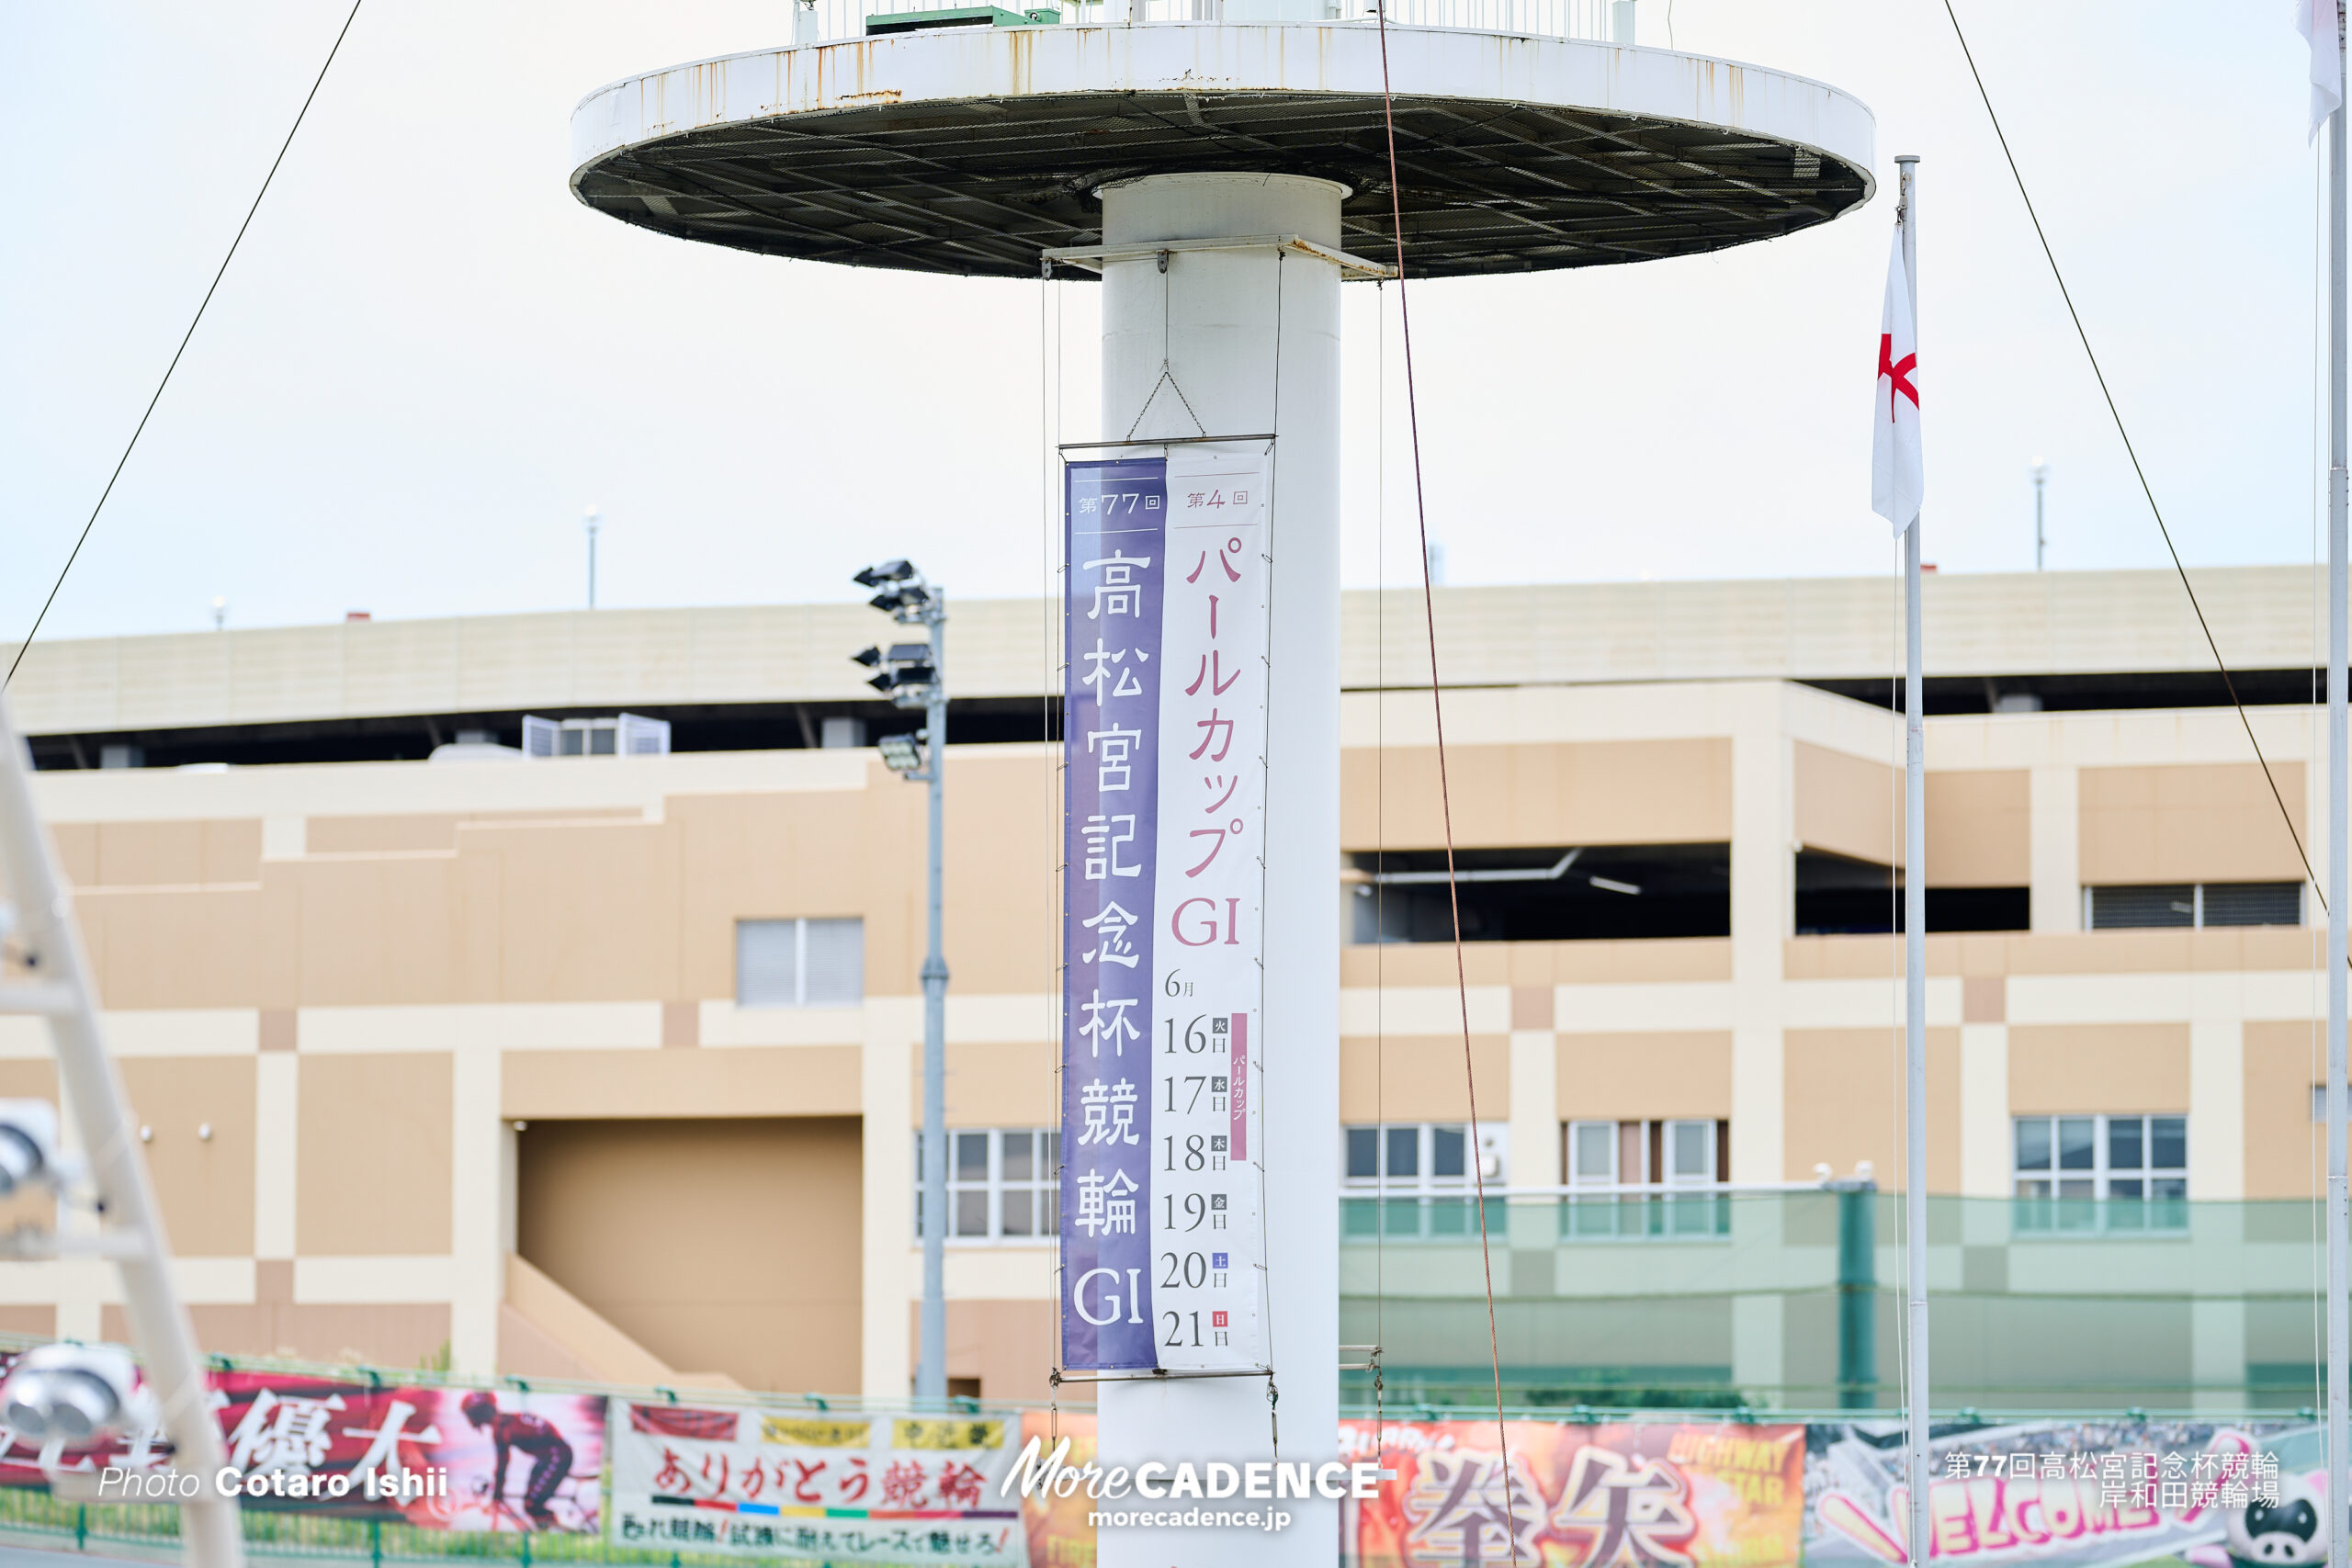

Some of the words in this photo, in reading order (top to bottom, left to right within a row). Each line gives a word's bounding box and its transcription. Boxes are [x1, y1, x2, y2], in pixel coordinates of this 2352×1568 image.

[1079, 492, 1160, 515] 第77回
[1187, 490, 1249, 510] 第4回
[1184, 536, 1244, 879] パールカップ
[1074, 548, 1151, 1237] 高松宮記念杯競輪
[1171, 897, 1240, 946] GI
[1165, 969, 1193, 997] 6月
[1232, 1055, 1246, 1121] パールカップ
[1073, 1268, 1144, 1325] GI
[655, 1448, 987, 1509] ありがとう競輪
